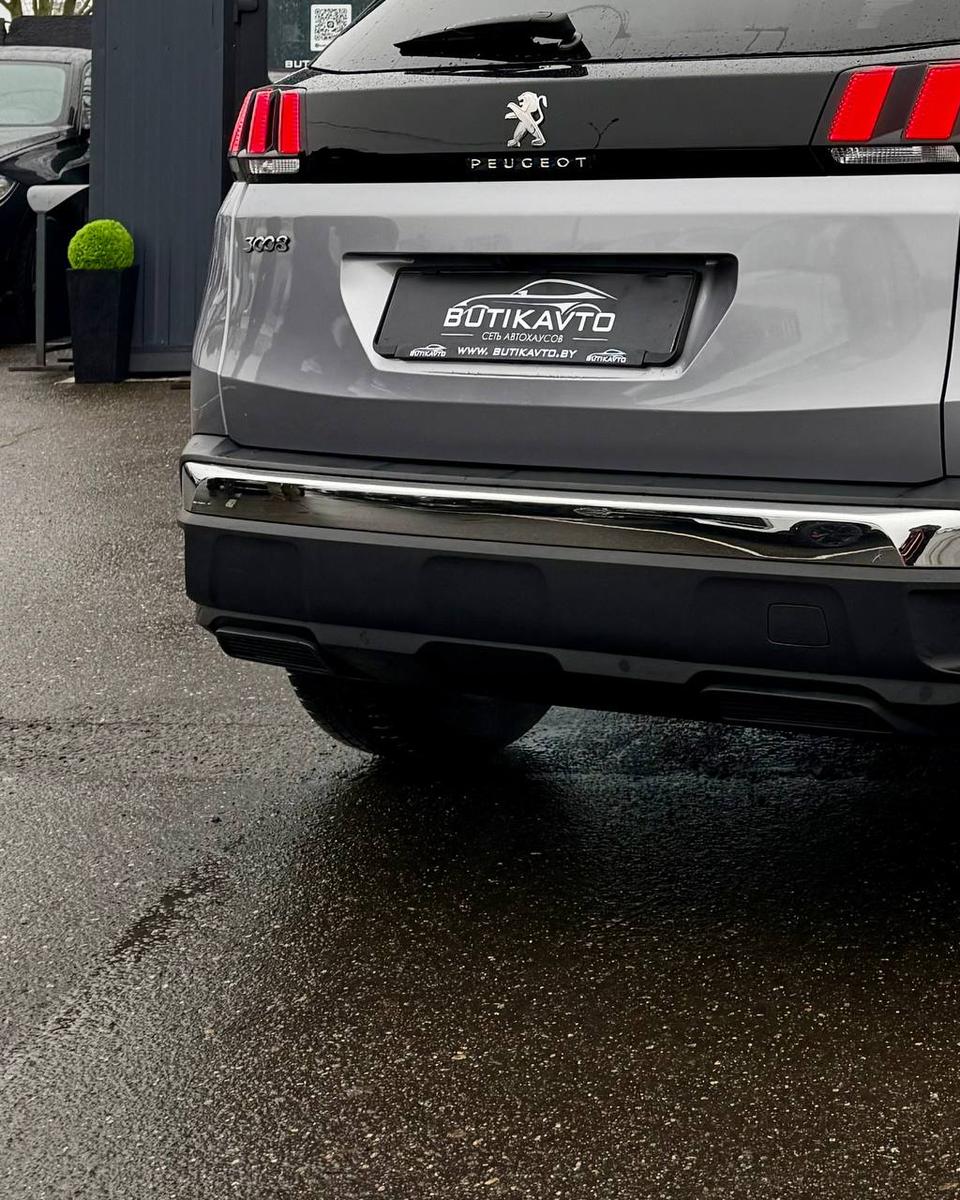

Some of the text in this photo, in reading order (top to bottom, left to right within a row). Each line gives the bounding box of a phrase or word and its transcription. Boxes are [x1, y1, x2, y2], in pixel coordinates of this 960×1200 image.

[471, 157, 587, 169] PEUGEOT
[242, 235, 291, 253] 3008
[443, 307, 616, 333] BUTIKAVTO
[481, 332, 564, 343] СЕТЬ АВТОХАУСОВ
[457, 346, 578, 359] WWW. BUTIKAVTO.BY
